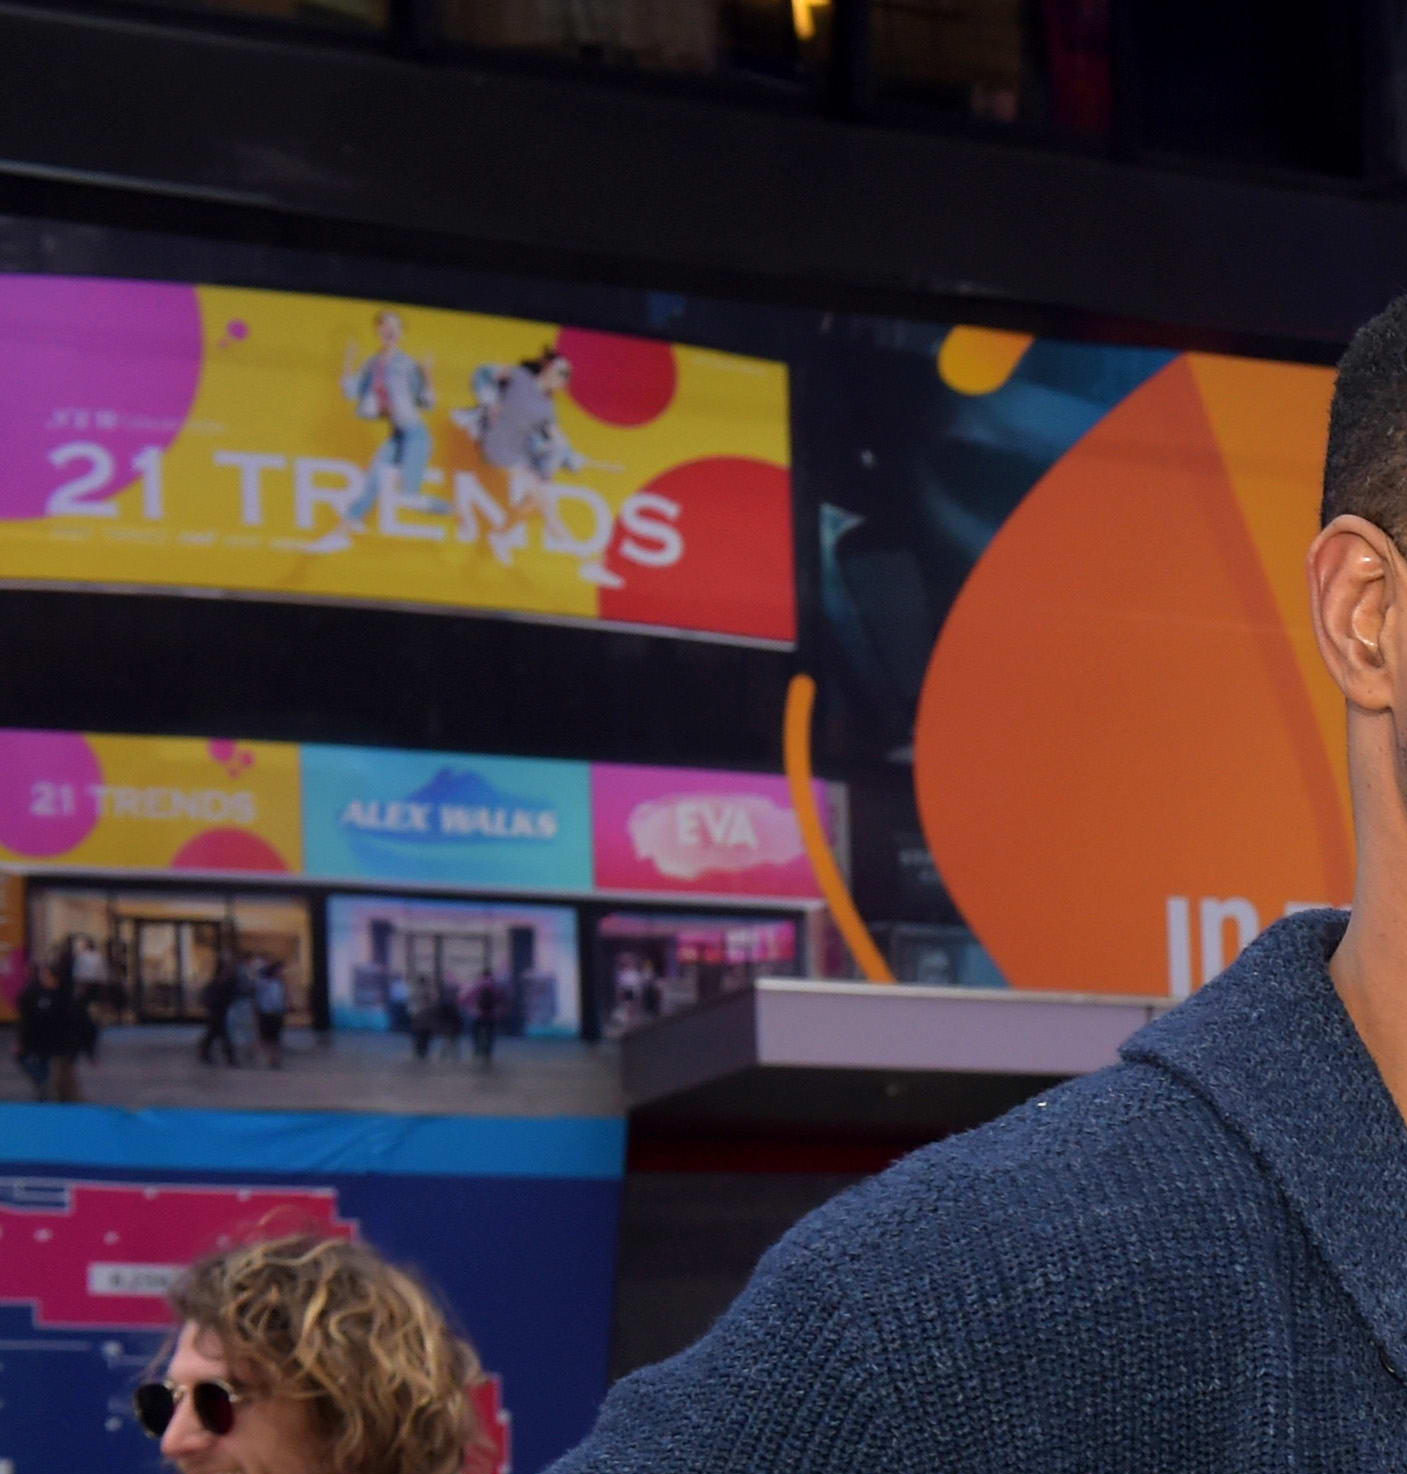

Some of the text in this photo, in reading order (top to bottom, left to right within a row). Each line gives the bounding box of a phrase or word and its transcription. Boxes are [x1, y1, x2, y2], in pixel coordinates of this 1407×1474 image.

[45, 441, 684, 567] 21 TRENDS
[29, 780, 258, 824] 21 TRENDS
[340, 799, 559, 839] ALEX WALKS
[675, 799, 760, 850] EVA
